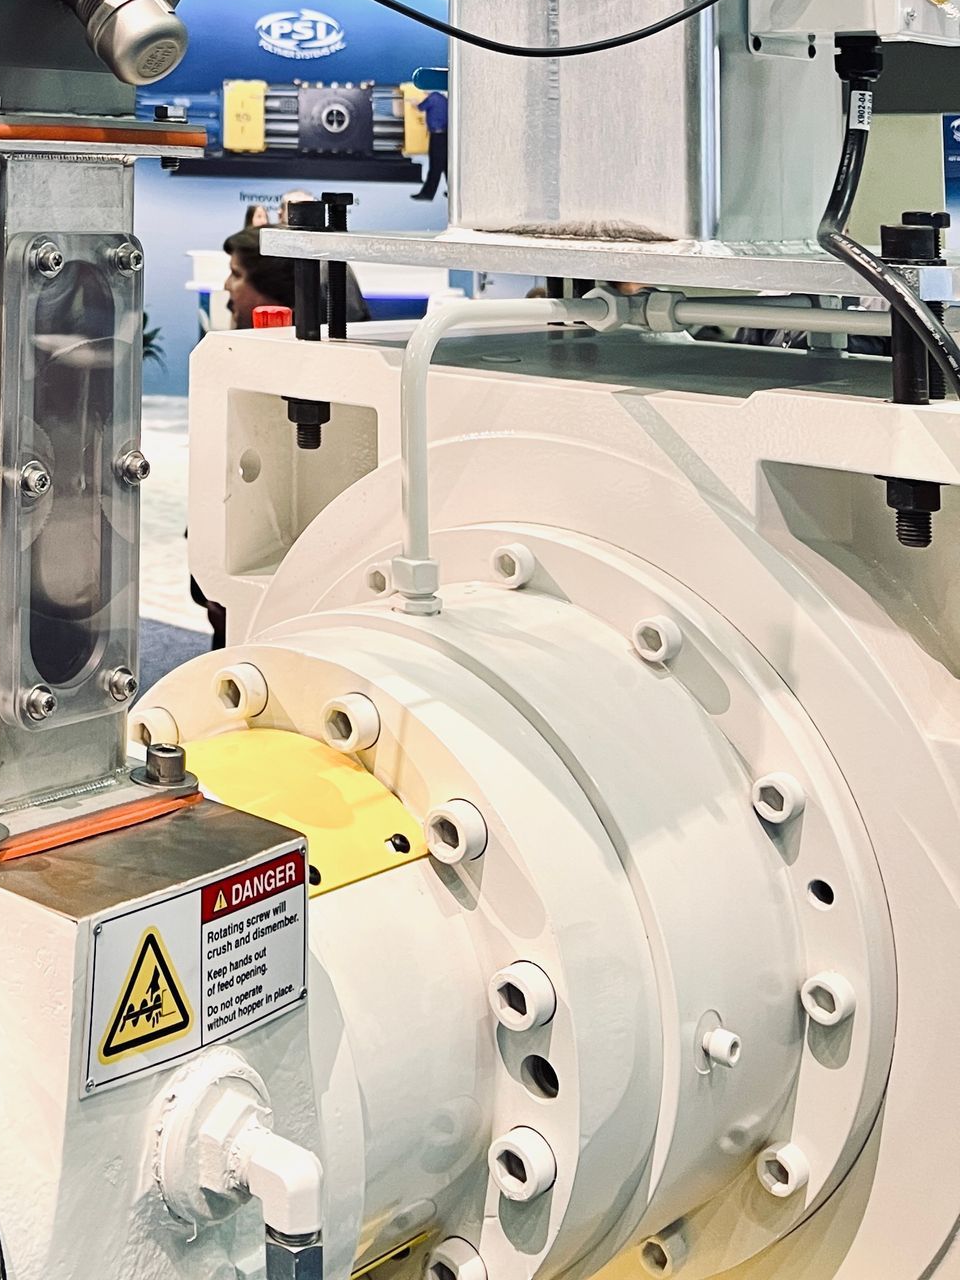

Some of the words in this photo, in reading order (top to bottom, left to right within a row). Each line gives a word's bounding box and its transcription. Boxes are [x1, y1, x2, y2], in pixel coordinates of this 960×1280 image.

[271, 20, 326, 40] PSI
[231, 861, 296, 906] DANGER
[207, 920, 244, 944] Rotating
[246, 909, 271, 928] screw
[272, 900, 287, 916] will
[207, 940, 233, 960] crush
[234, 931, 250, 949] and
[252, 912, 300, 941] dismember.
[207, 965, 228, 982] Keep
[229, 954, 253, 972] hands
[254, 946, 267, 961] out
[207, 983, 216, 997] of
[217, 976, 234, 993] feed
[235, 963, 268, 985] opening.
[207, 1005, 219, 1017] Do
[220, 998, 234, 1011] not
[234, 984, 263, 1005] operate
[207, 1010, 236, 1031] without
[237, 998, 264, 1017] hopper
[265, 993, 272, 1004] in
[273, 984, 295, 1002] place.
